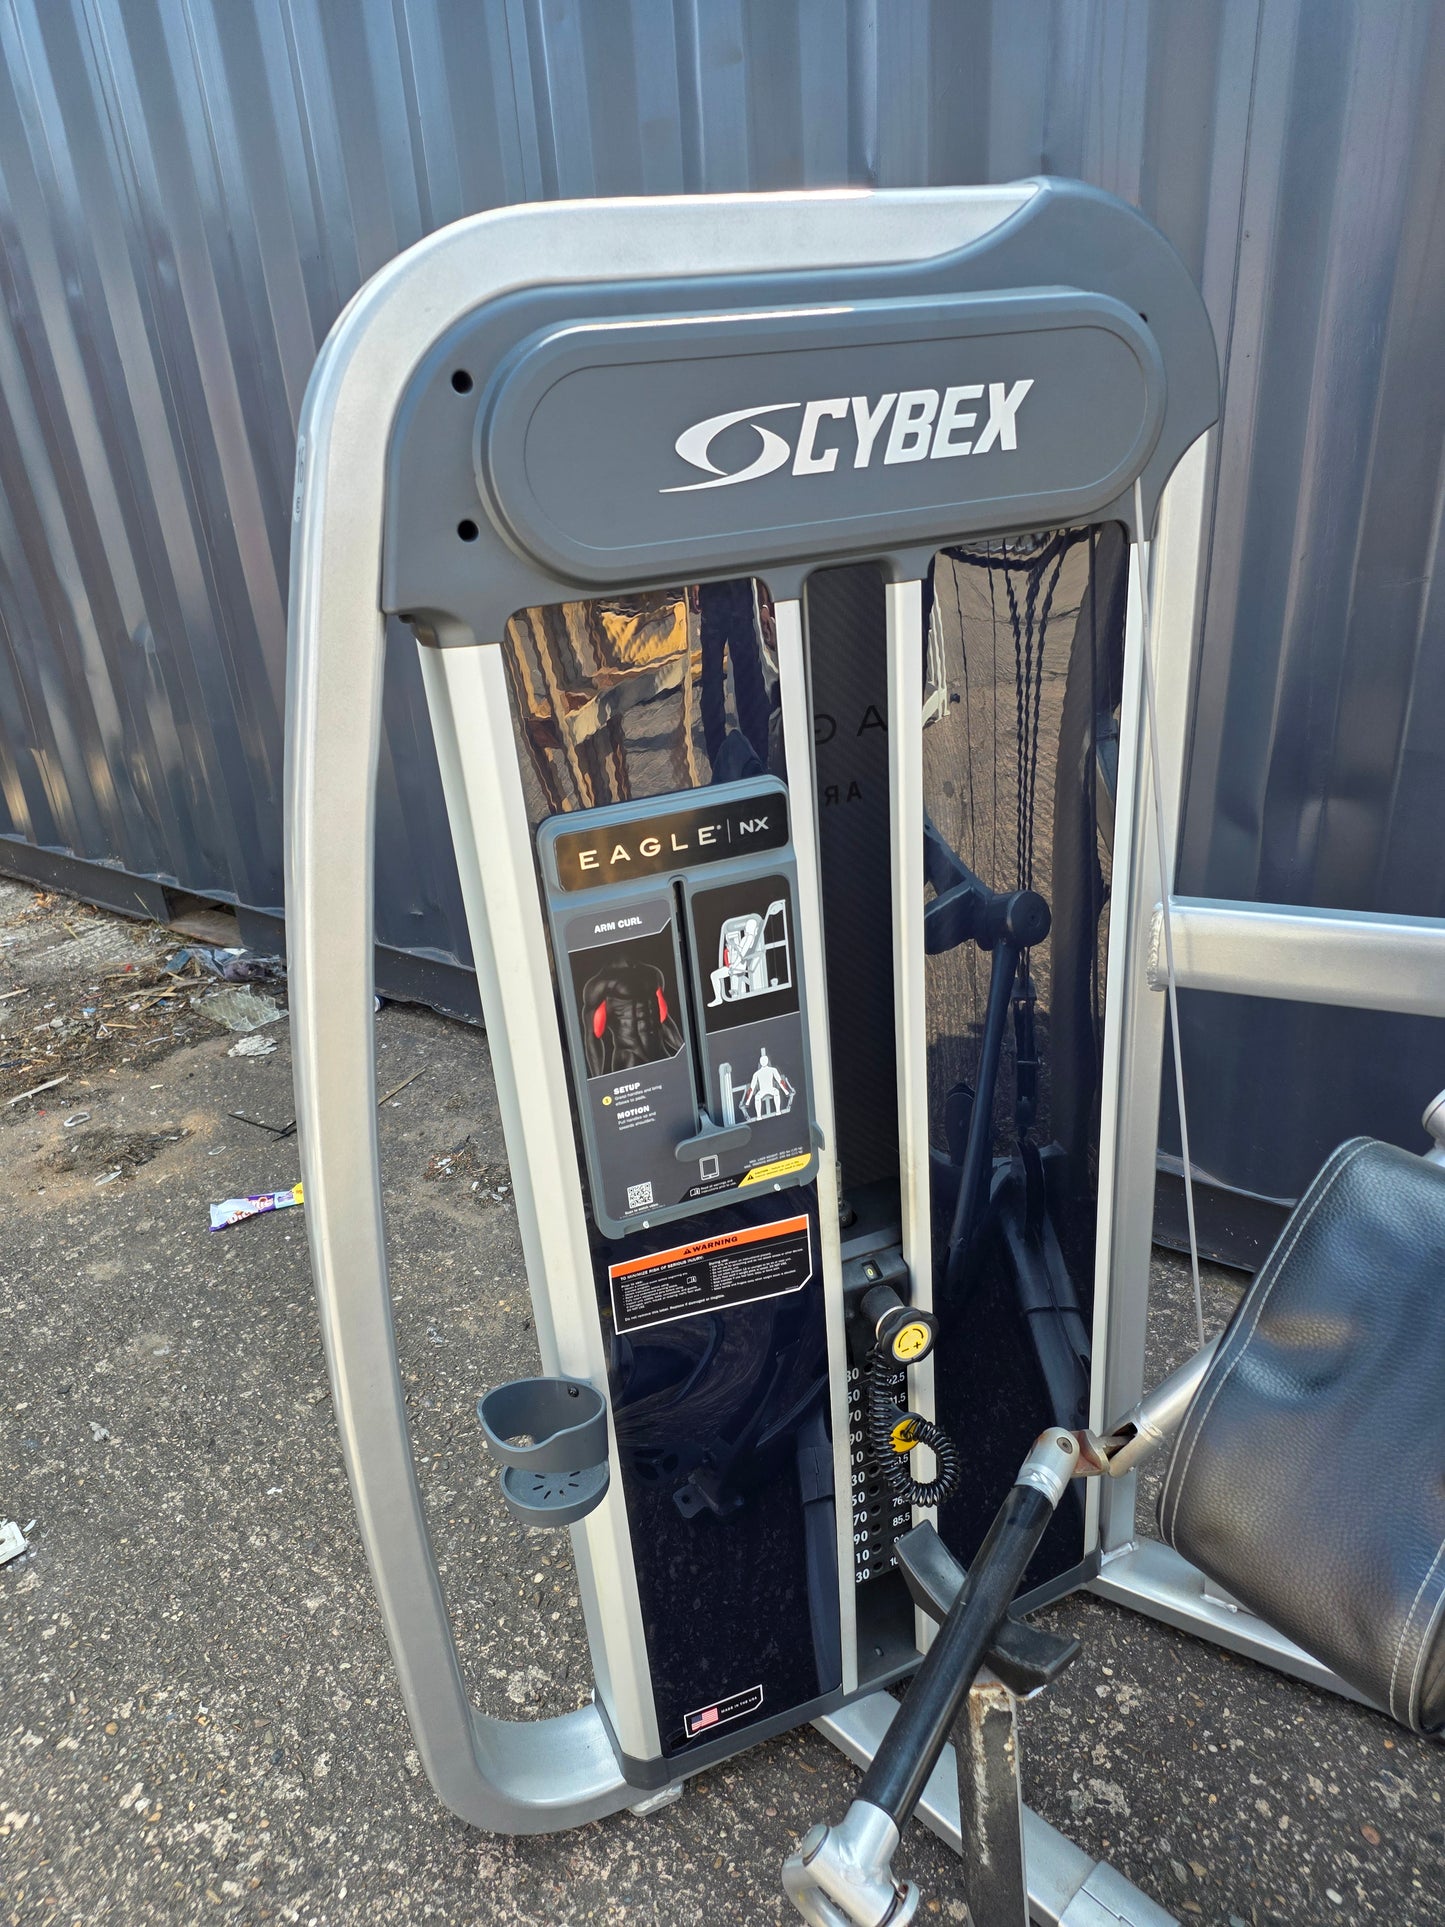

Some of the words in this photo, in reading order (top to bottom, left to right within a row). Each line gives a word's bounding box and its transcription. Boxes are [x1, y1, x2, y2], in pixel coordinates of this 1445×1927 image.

[792, 379, 1034, 476] CYBEX
[578, 825, 718, 871] EAGLE
[739, 816, 770, 836] NX
[594, 921, 616, 934] ARM
[617, 916, 643, 929] CURL
[613, 1082, 641, 1095] SETUP
[617, 1104, 650, 1120] MOTION
[692, 1235, 738, 1253] WARNING
[892, 1512, 911, 1527] 85.5
